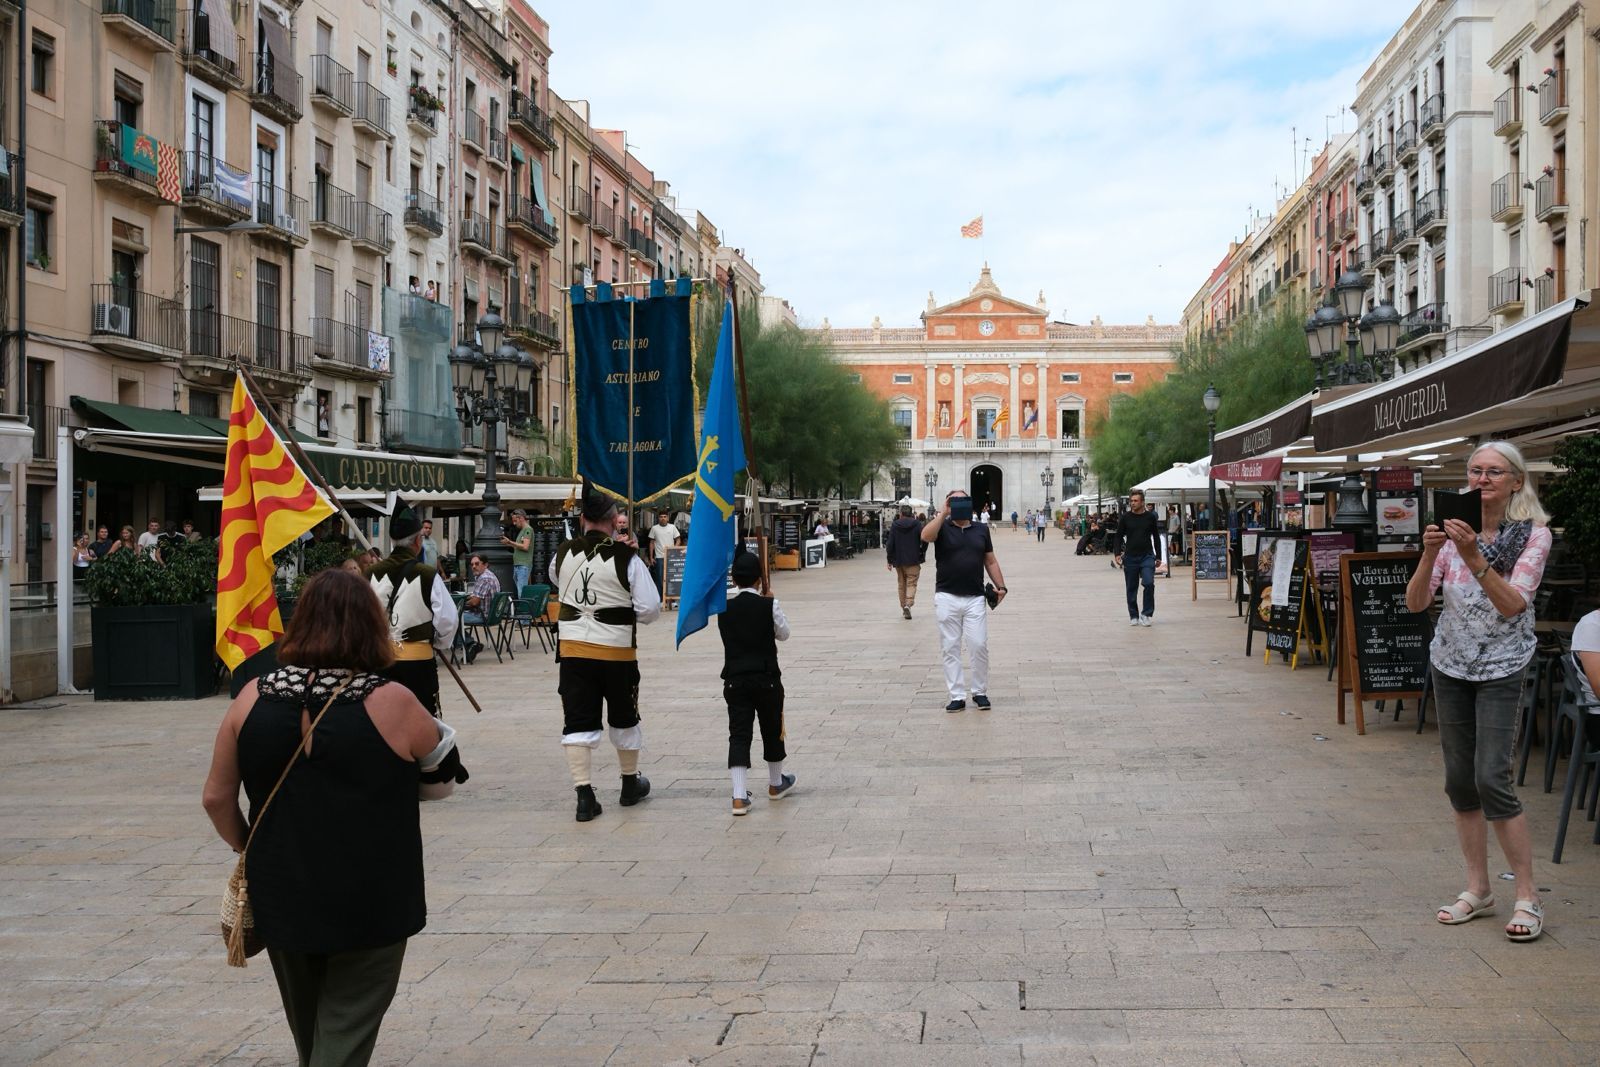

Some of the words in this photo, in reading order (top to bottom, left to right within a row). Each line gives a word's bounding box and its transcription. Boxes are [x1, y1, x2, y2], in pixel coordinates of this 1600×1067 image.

[612, 338, 649, 351] CENTRO
[605, 370, 660, 384] ASTURIANO
[1374, 381, 1448, 431] MALQUERIDA
[609, 440, 662, 453] TARAGONA
[1242, 428, 1272, 455] MALQUERIDA
[1351, 572, 1409, 586] Vermut
[1368, 589, 1375, 598] 2
[1371, 627, 1378, 636] 2
